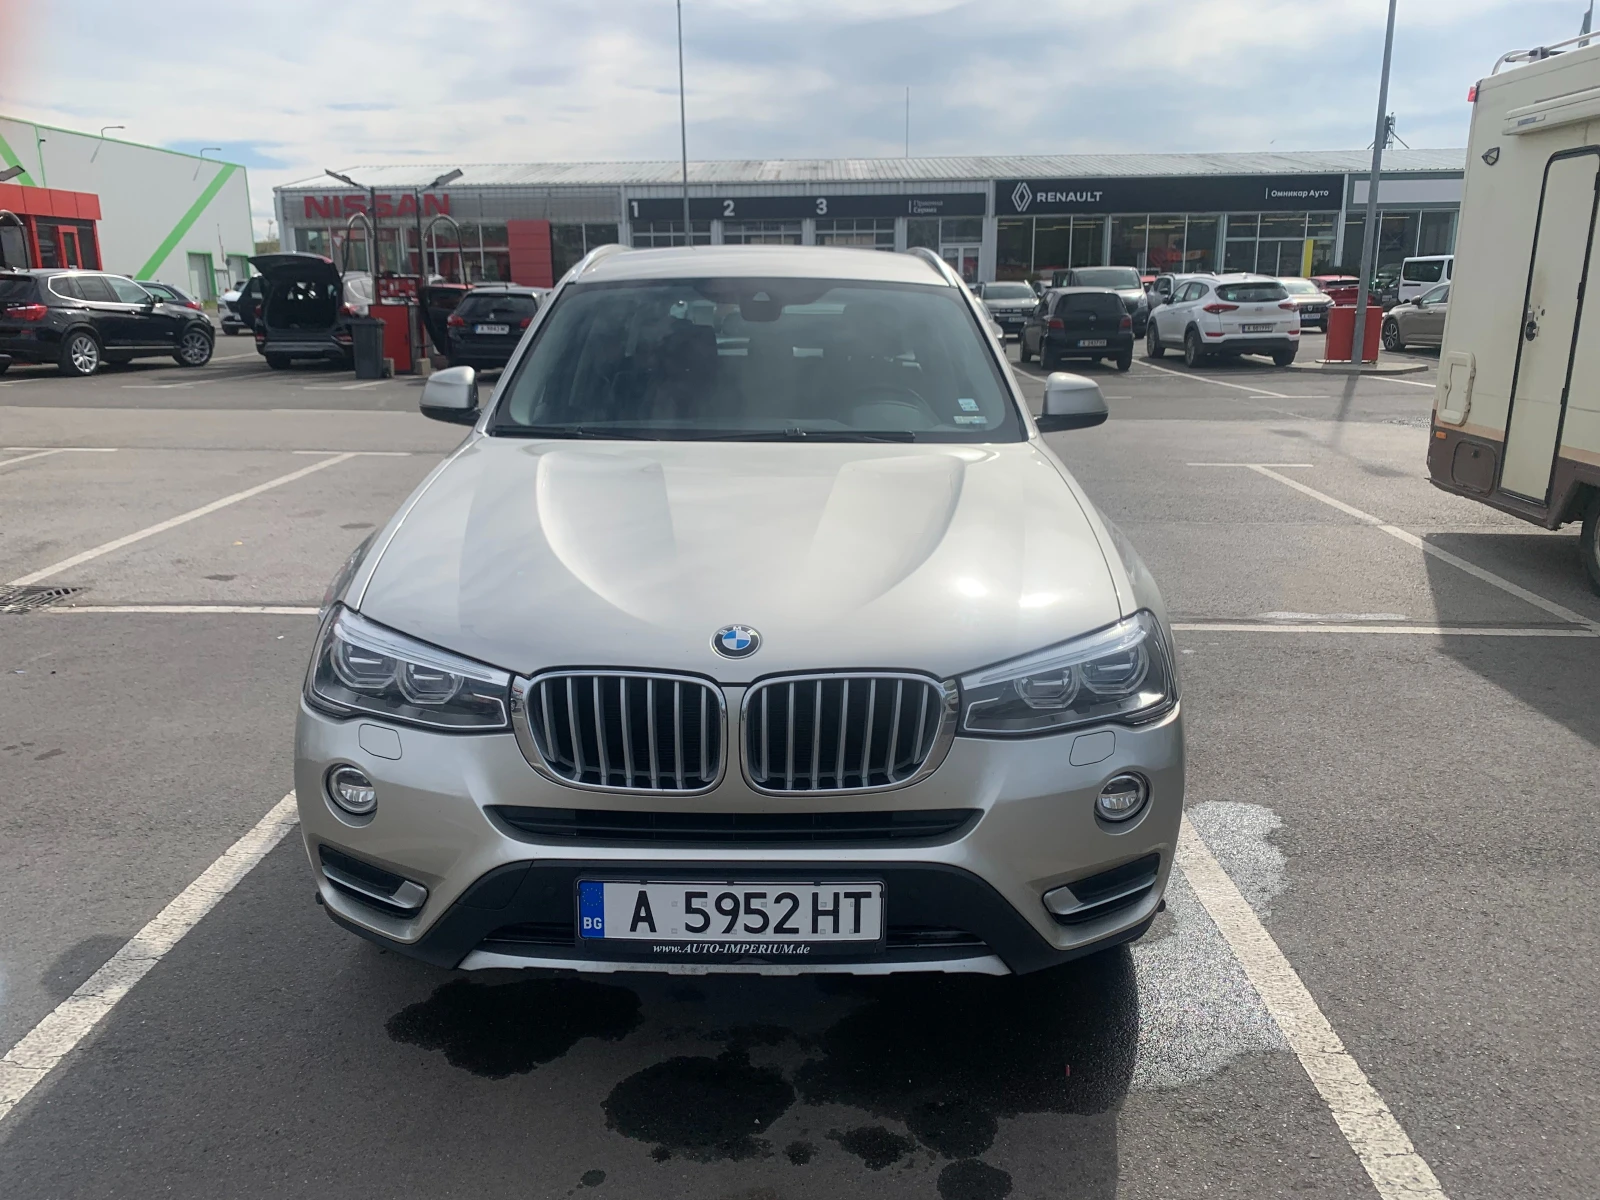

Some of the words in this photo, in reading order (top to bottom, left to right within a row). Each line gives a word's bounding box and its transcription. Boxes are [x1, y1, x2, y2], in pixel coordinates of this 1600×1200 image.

[1036, 191, 1103, 203] RENAULT
[1309, 189, 1329, 198] Ауто
[303, 194, 450, 219] NISSAN
[631, 201, 639, 218] 1
[723, 200, 735, 216] 2
[816, 198, 828, 215] 3
[629, 890, 657, 933] A
[684, 891, 800, 934] 5952
[811, 891, 872, 934] HT
[583, 916, 603, 930] BG
[653, 943, 811, 954] www.AUTO-IMPERIUM.de
